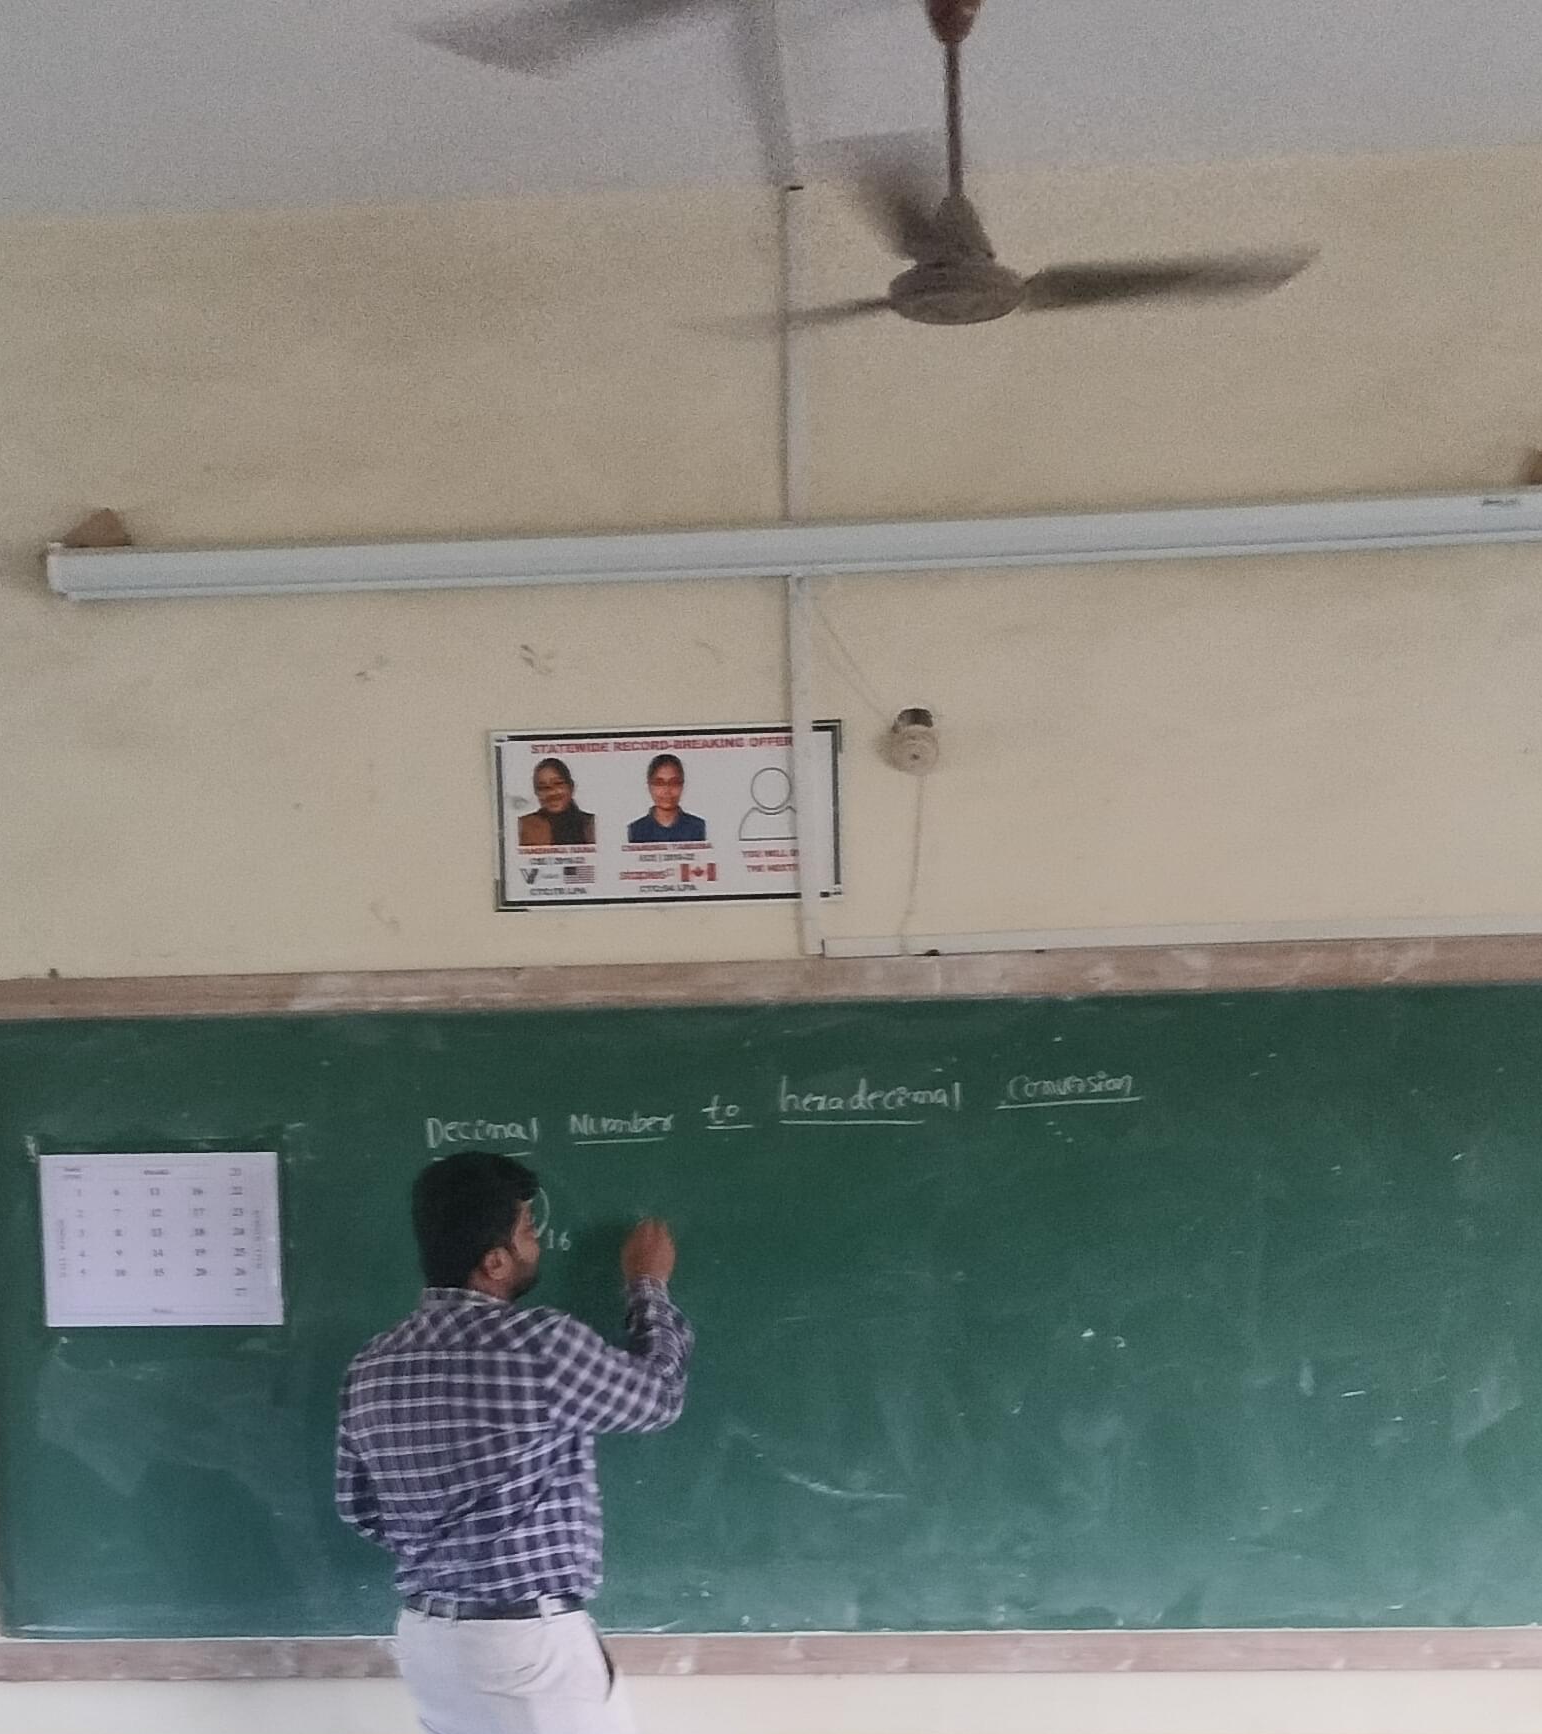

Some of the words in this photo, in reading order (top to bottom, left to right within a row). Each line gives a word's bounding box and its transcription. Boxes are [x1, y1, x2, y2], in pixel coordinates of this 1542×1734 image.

[531, 741, 609, 754] STATEWIDE
[750, 735, 793, 748] OFFER
[425, 1116, 539, 1148] Decimal
[701, 1094, 740, 1124] to
